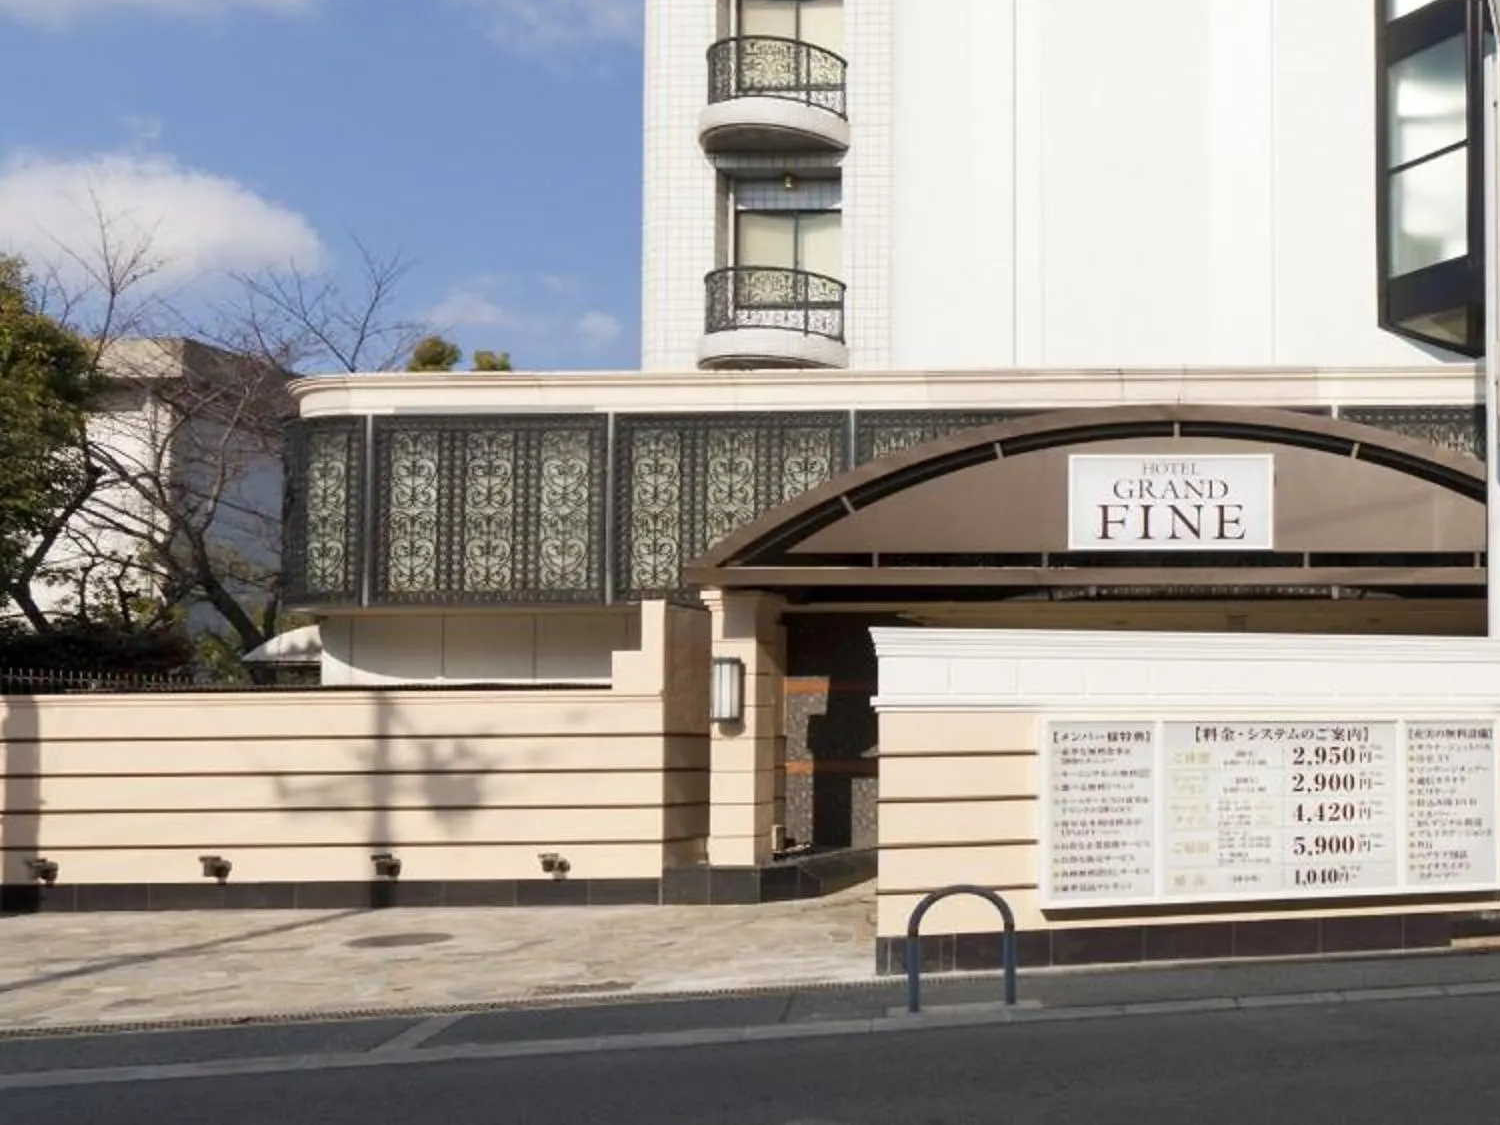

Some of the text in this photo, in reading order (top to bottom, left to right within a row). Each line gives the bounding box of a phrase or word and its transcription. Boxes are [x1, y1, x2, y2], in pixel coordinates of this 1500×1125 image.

[1142, 462, 1200, 476] HOTEL
[1113, 478, 1229, 500] GRAND
[1096, 504, 1246, 540] FINE
